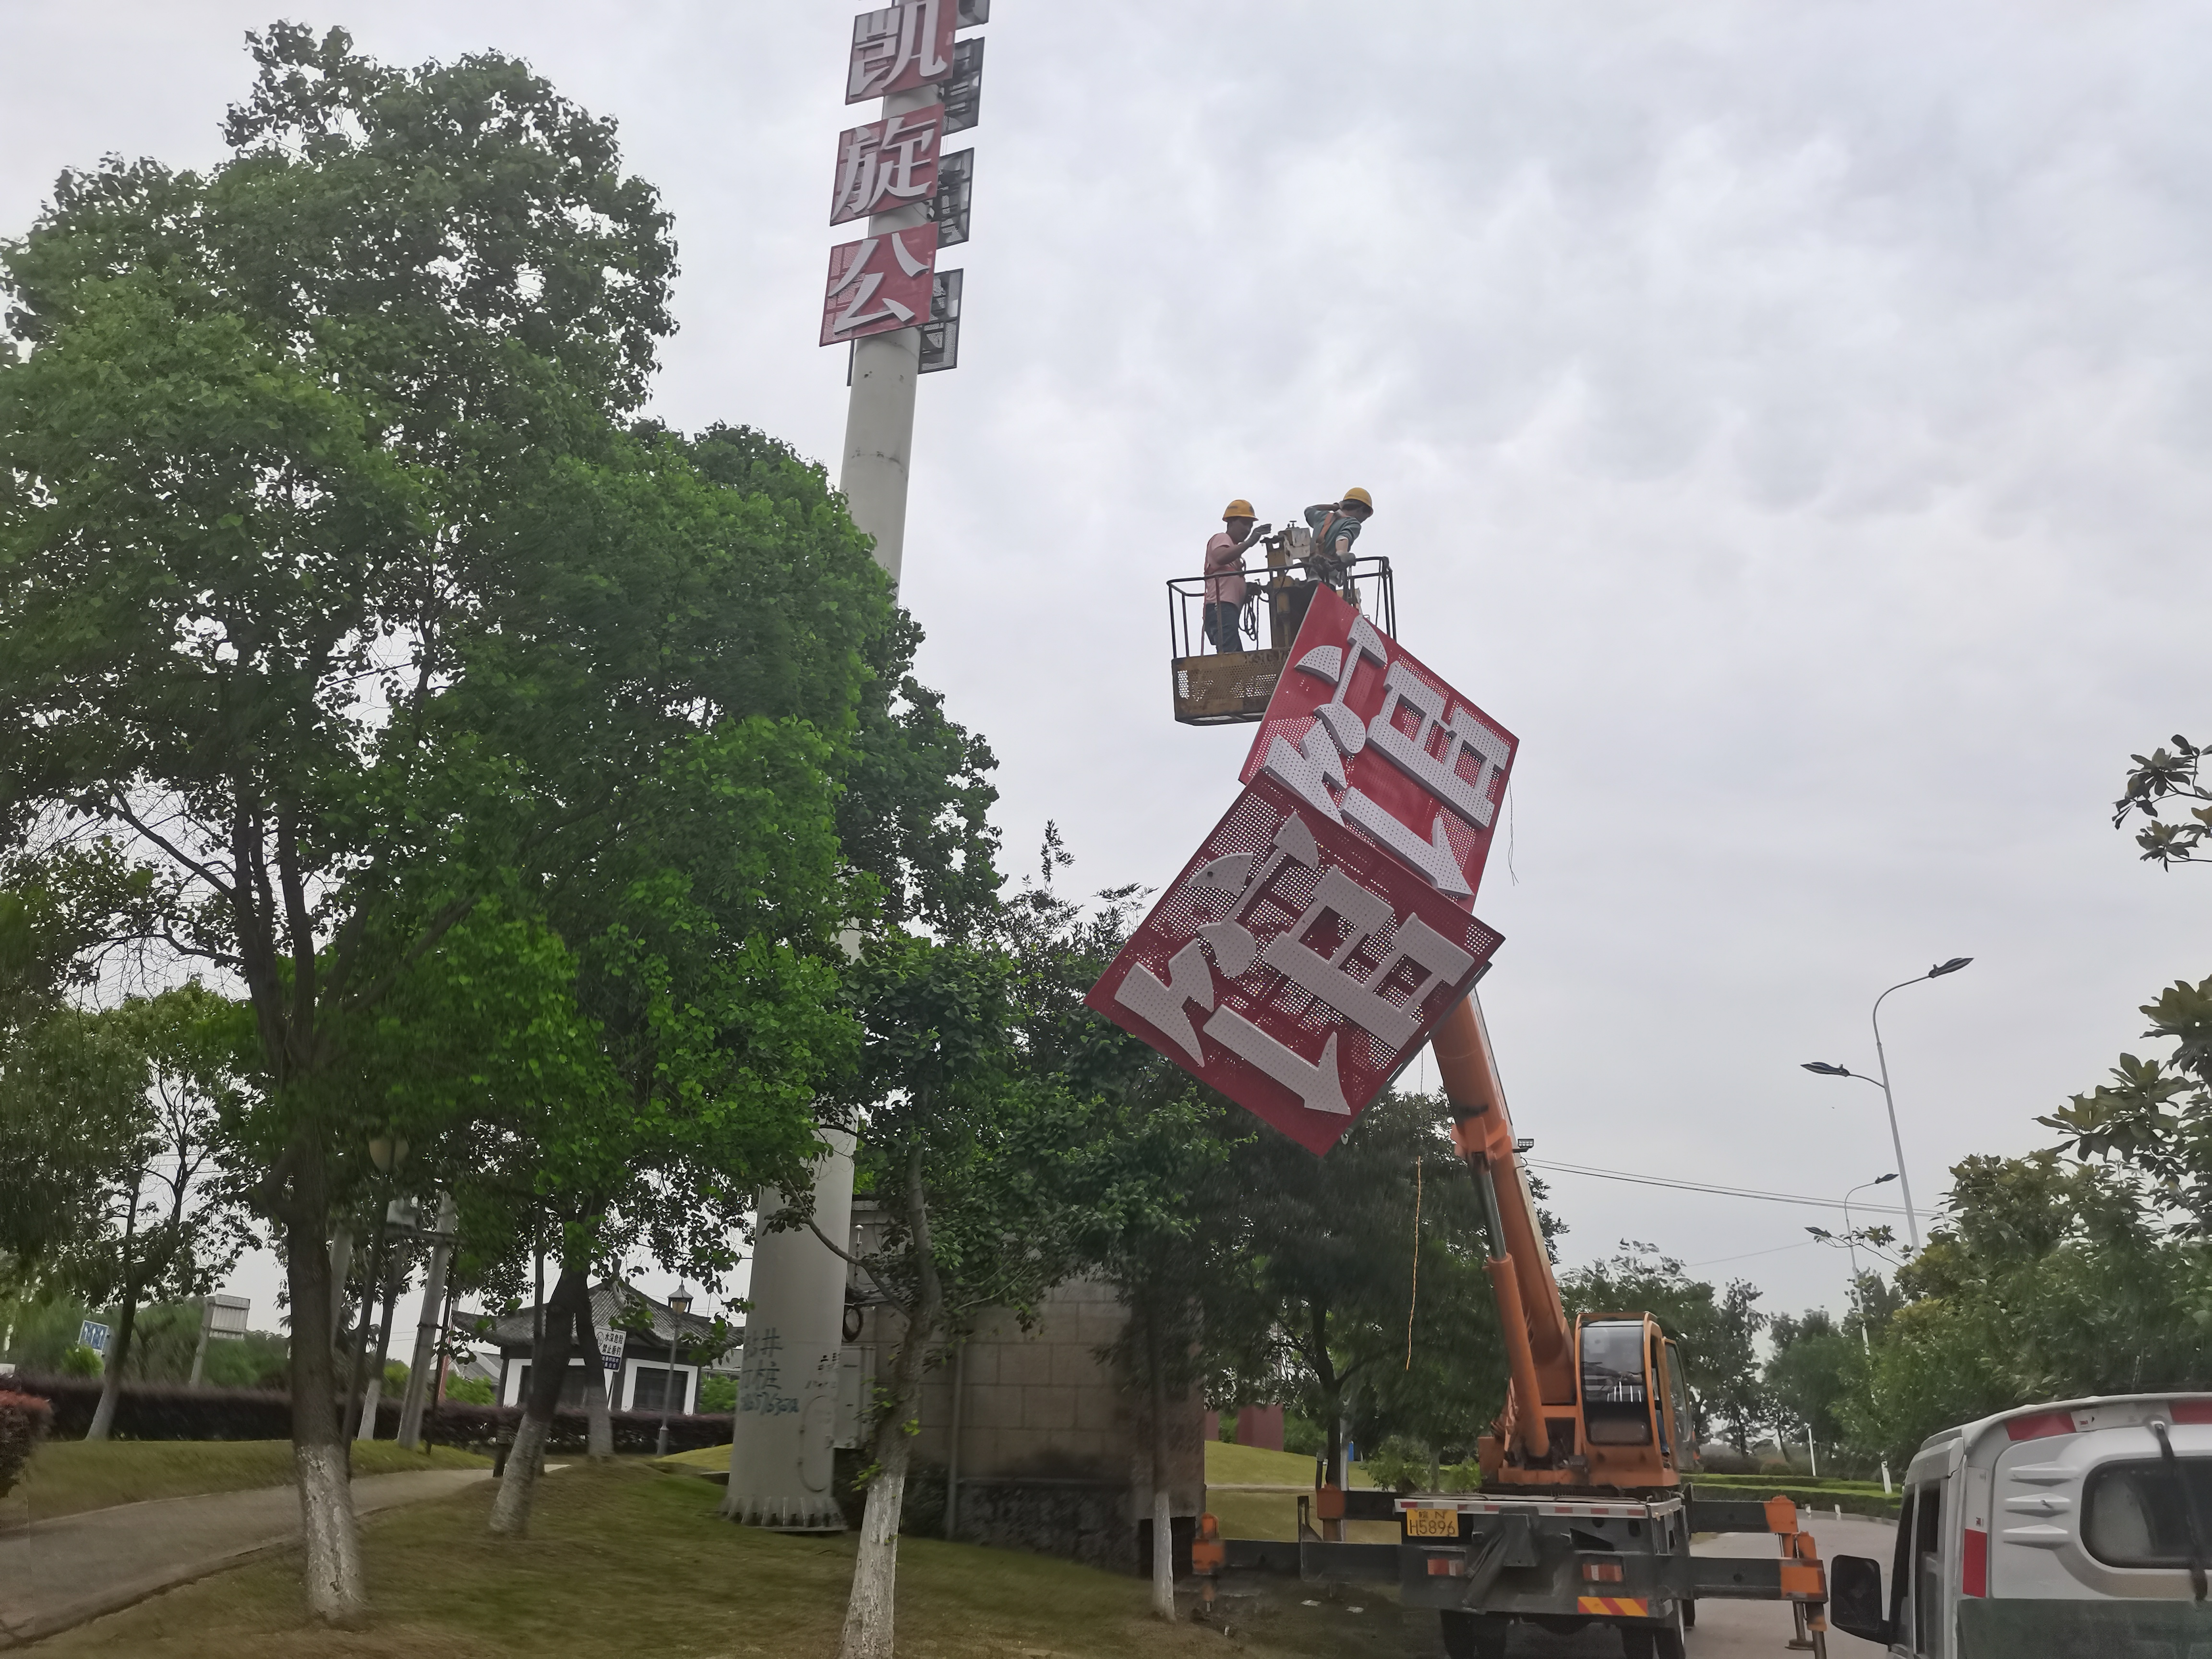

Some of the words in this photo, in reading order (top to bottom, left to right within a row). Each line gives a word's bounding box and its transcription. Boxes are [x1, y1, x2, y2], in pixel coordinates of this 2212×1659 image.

[828, 1, 948, 334] 凯旋公
[1264, 615, 1511, 895] 馆
[1114, 812, 1475, 1116] 馆
[602, 1344, 621, 1356] 禁止垂钓
[604, 1332, 623, 1344] 水深危险
[1409, 1519, 1455, 1535] H5896
